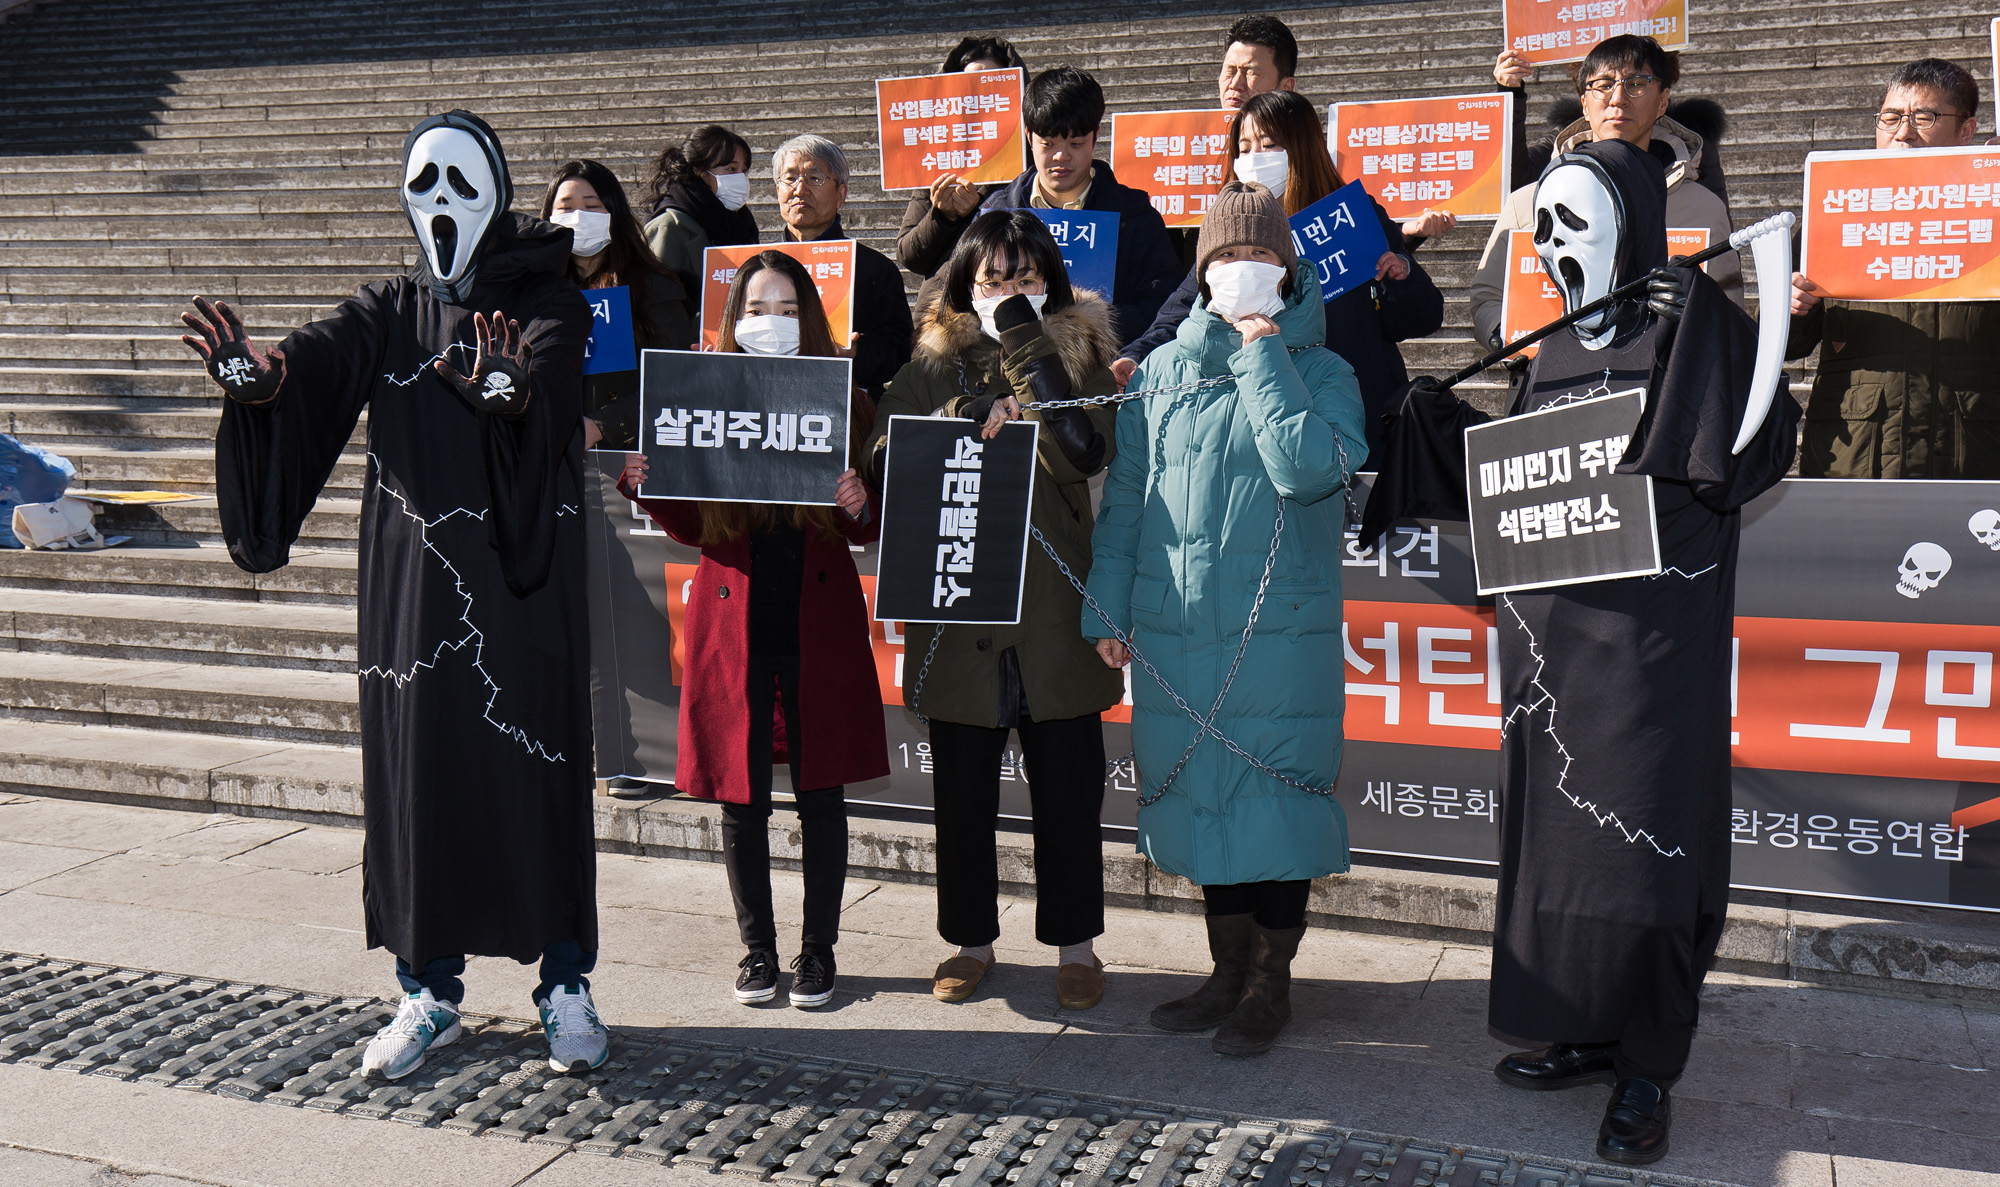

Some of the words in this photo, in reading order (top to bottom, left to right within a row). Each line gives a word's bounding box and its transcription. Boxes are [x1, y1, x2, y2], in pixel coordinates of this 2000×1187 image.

[1557, 0, 1627, 23] 수명연장?
[1513, 30, 1571, 53] 석탄발전
[1575, 26, 1605, 45] 조기
[888, 93, 1011, 121] 산업통상자원부는
[903, 125, 949, 146] 탈석탄
[951, 120, 998, 142] 로드맵
[1134, 135, 1186, 158] 침묵의
[1190, 134, 1231, 156] 살인
[1347, 121, 1491, 147] 산업통상자원부는
[921, 149, 982, 171] 수립하라
[1362, 152, 1416, 175] 탈석탄
[1419, 150, 1474, 172] 로드맵
[1381, 180, 1454, 202] 수립하라
[1151, 195, 1184, 216] 이제
[1048, 220, 1096, 249] 먼지
[1842, 221, 1914, 247] 탈석탄
[1919, 218, 1993, 245] 로드맵
[815, 262, 843, 279] 한국
[1317, 249, 1348, 284] UT
[1866, 255, 1964, 280] 수립하라
[218, 357, 256, 386] 석탄
[654, 407, 833, 453] 살려주세요
[1479, 446, 1572, 497] 미세먼지
[932, 435, 984, 608] 석탄발전소
[1498, 493, 1621, 544] 석탄발전소
